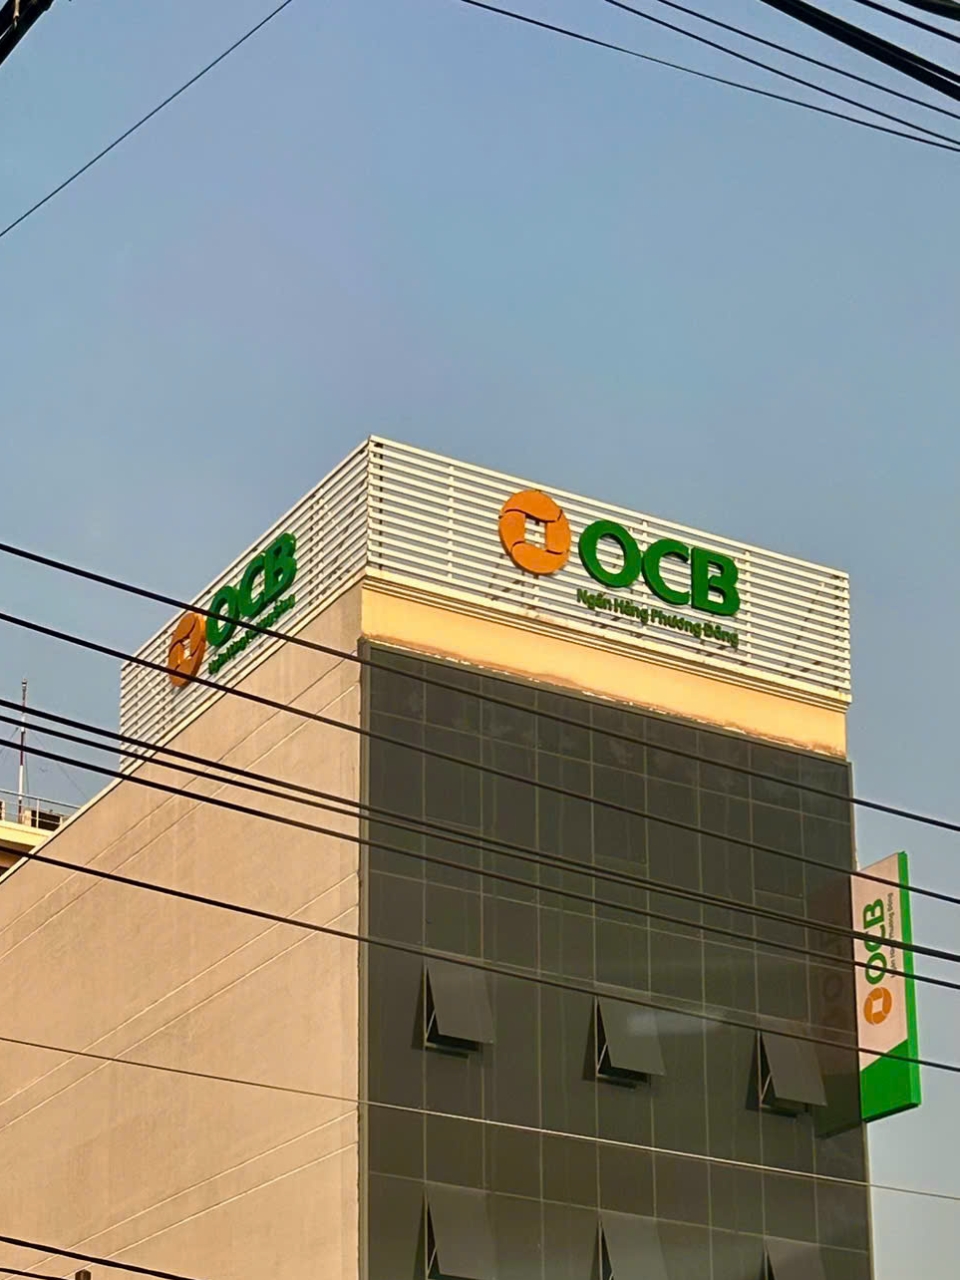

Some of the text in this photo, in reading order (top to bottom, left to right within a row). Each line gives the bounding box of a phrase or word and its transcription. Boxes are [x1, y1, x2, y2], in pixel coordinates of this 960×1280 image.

[205, 532, 297, 646] OCB
[578, 519, 740, 616] OCB
[863, 898, 887, 985] OCB
